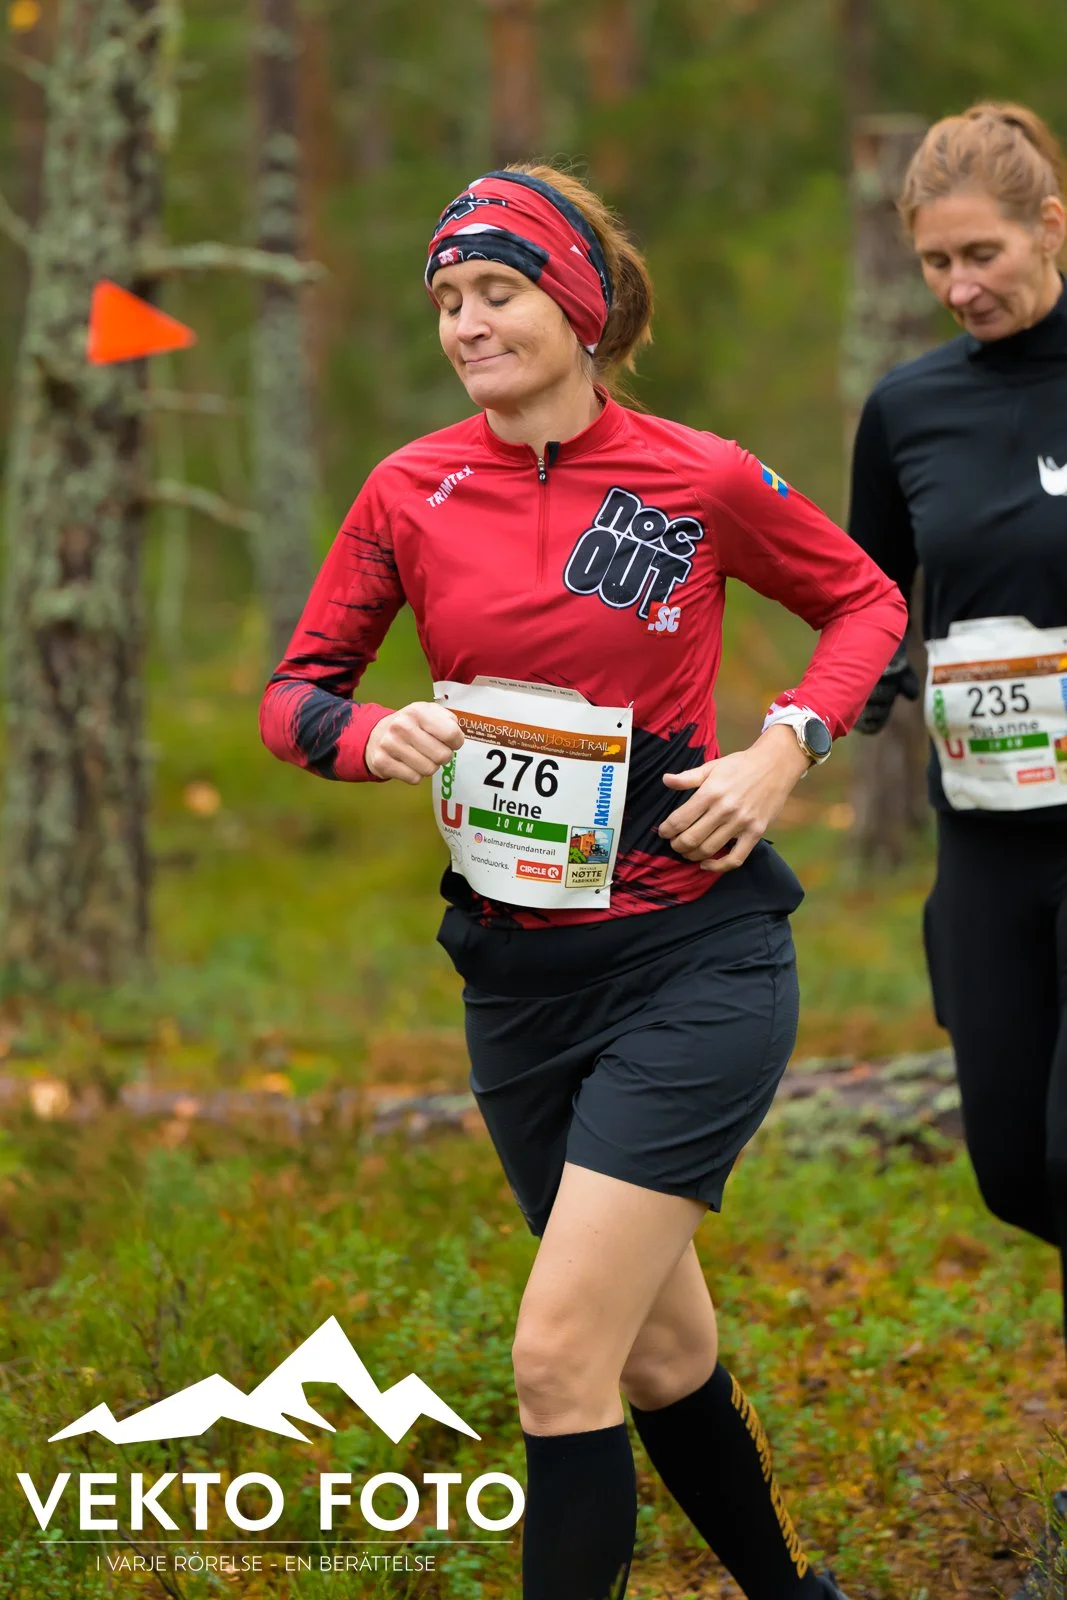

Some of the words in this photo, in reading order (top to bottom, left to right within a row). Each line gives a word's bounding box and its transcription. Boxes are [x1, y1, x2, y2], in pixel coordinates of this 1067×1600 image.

[425, 464, 475, 508] TRIMTEX
[968, 684, 1030, 718] 235
[483, 749, 559, 798] 276
[492, 793, 542, 819] Irene
[594, 765, 615, 827] Aktivitus
[496, 816, 510, 829] 10
[517, 819, 534, 834] KM
[483, 835, 556, 856] kolmardsrundantrail
[519, 864, 547, 876] CIRCLE
[571, 870, 602, 878] NØTTE
